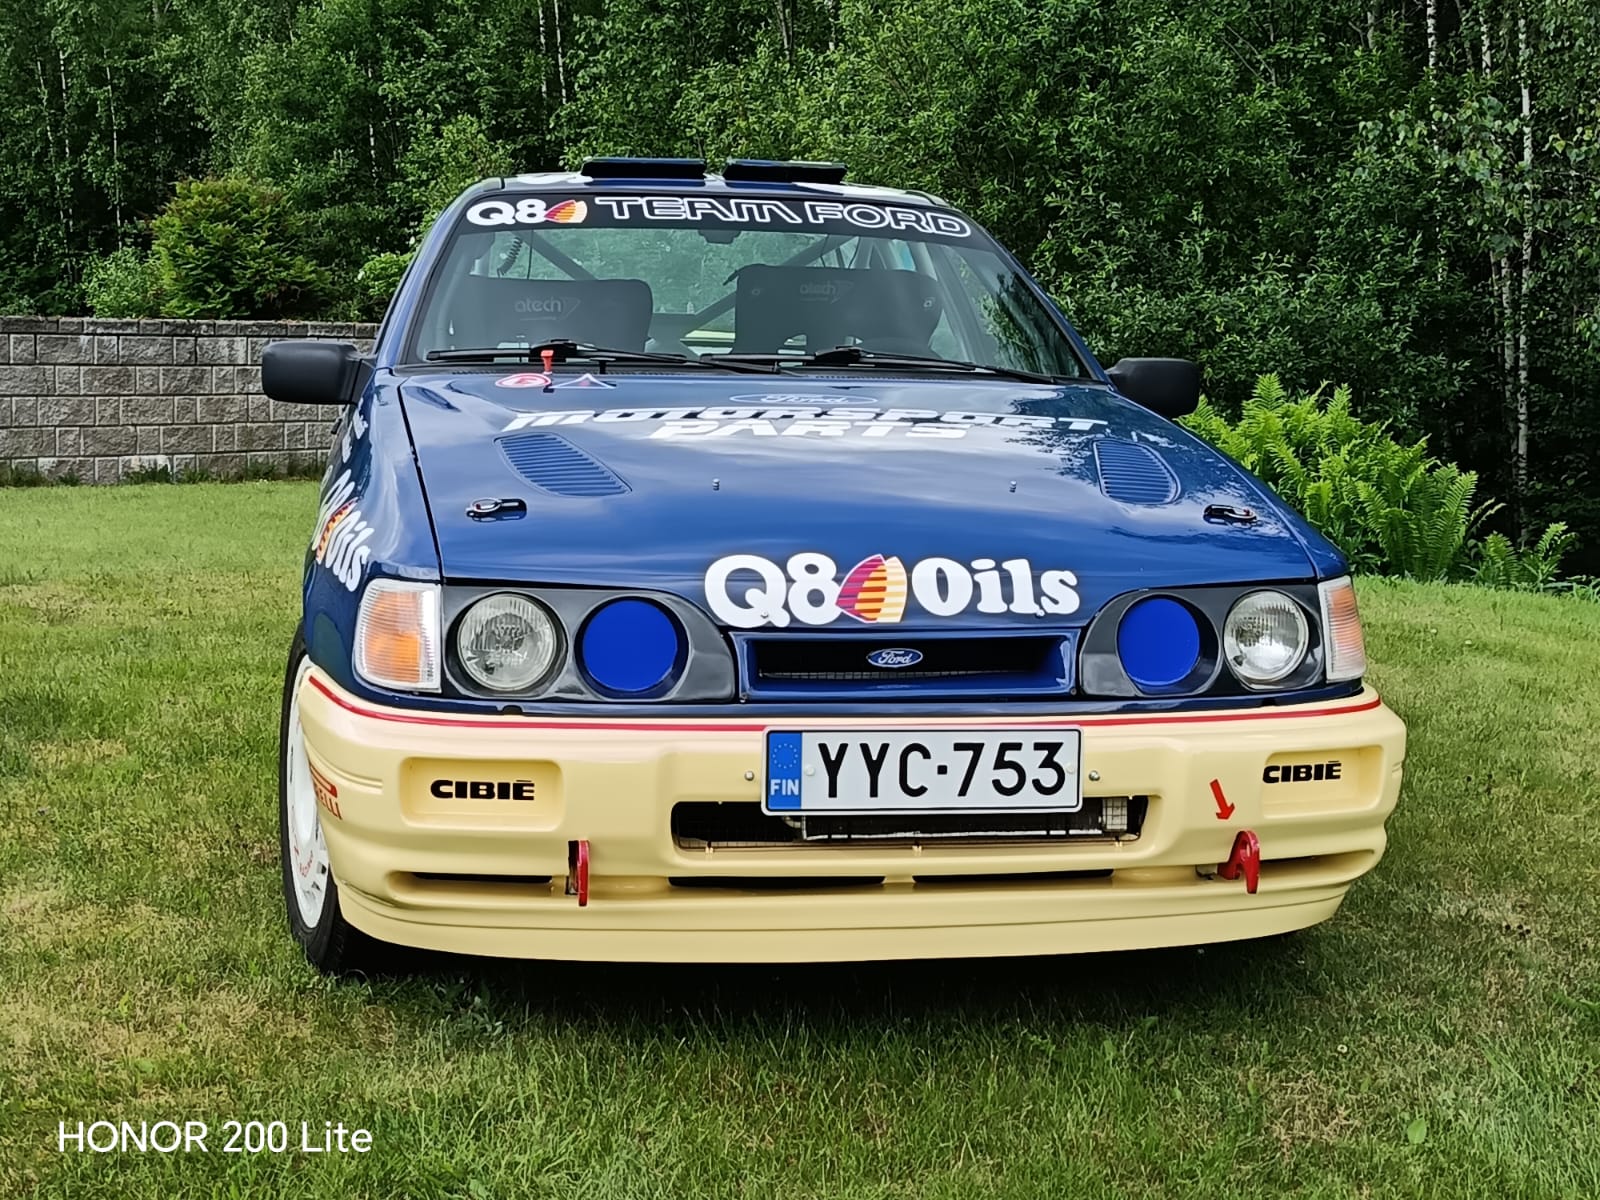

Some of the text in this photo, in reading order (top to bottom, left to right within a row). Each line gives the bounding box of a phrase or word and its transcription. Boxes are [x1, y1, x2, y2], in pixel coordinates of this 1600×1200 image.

[466, 196, 971, 237] Q8 TEAM FORD
[502, 406, 1108, 432] MOTORSPORT
[649, 419, 970, 439] PARTS
[704, 552, 1080, 628] Q8 Oils
[878, 650, 913, 664] Ford
[770, 778, 799, 796] FIN
